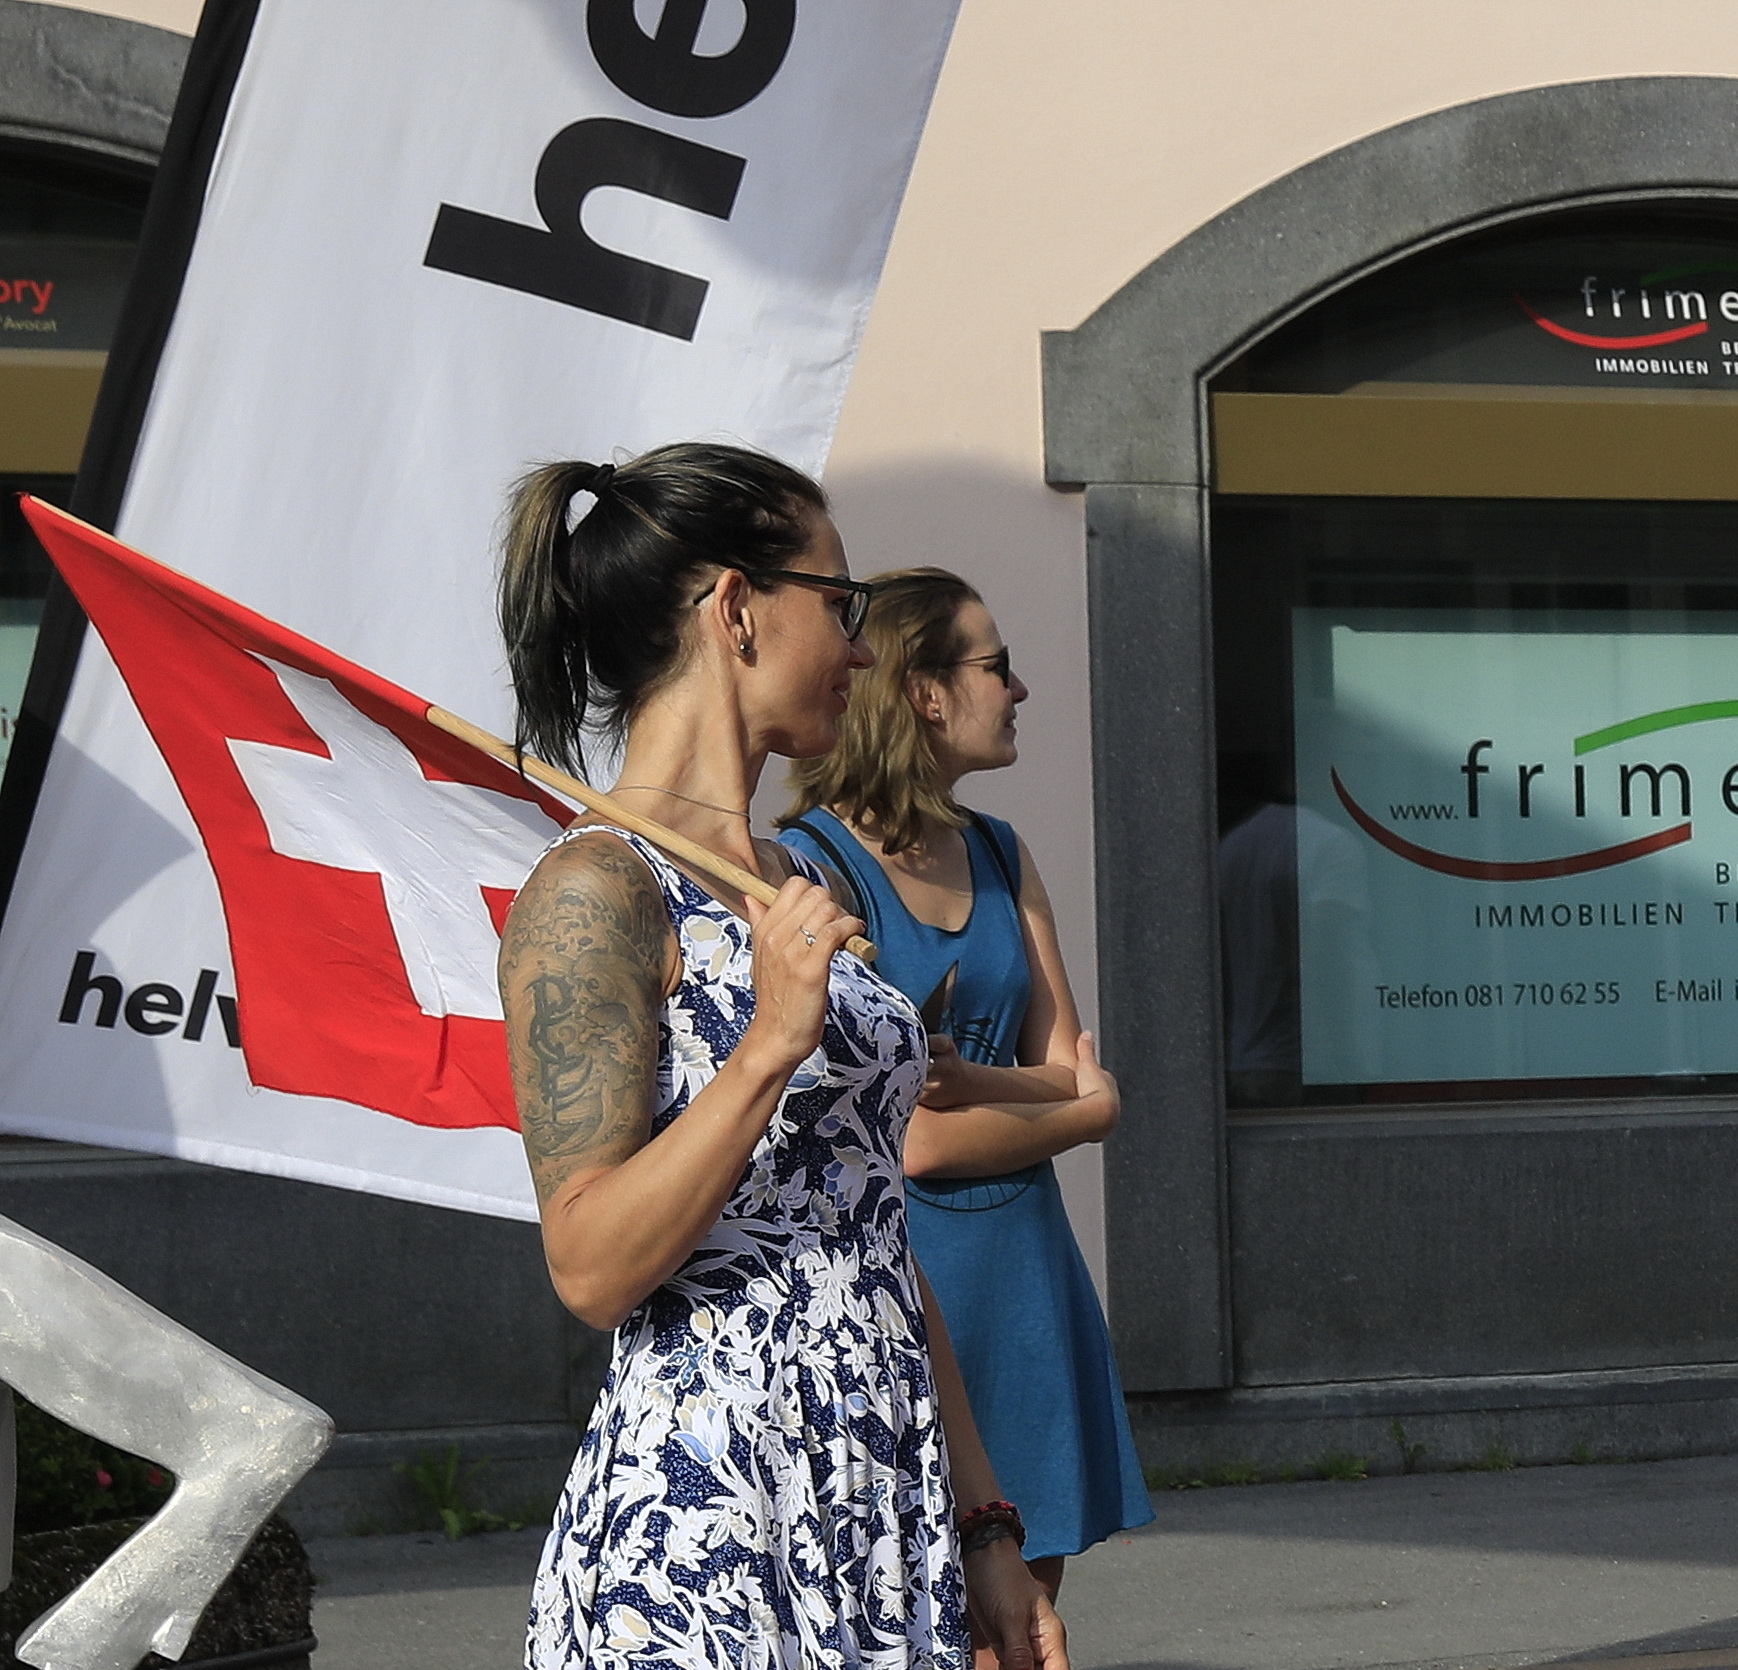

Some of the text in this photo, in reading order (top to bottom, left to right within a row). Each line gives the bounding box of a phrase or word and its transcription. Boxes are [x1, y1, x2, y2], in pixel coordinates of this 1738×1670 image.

[1595, 358, 1709, 375] IMMOBILIEN
[1475, 902, 1684, 928] IMMOBILIEN
[1375, 982, 1620, 1008] Telefon 081 710 62 55
[1655, 979, 1723, 1002] E-Mail
